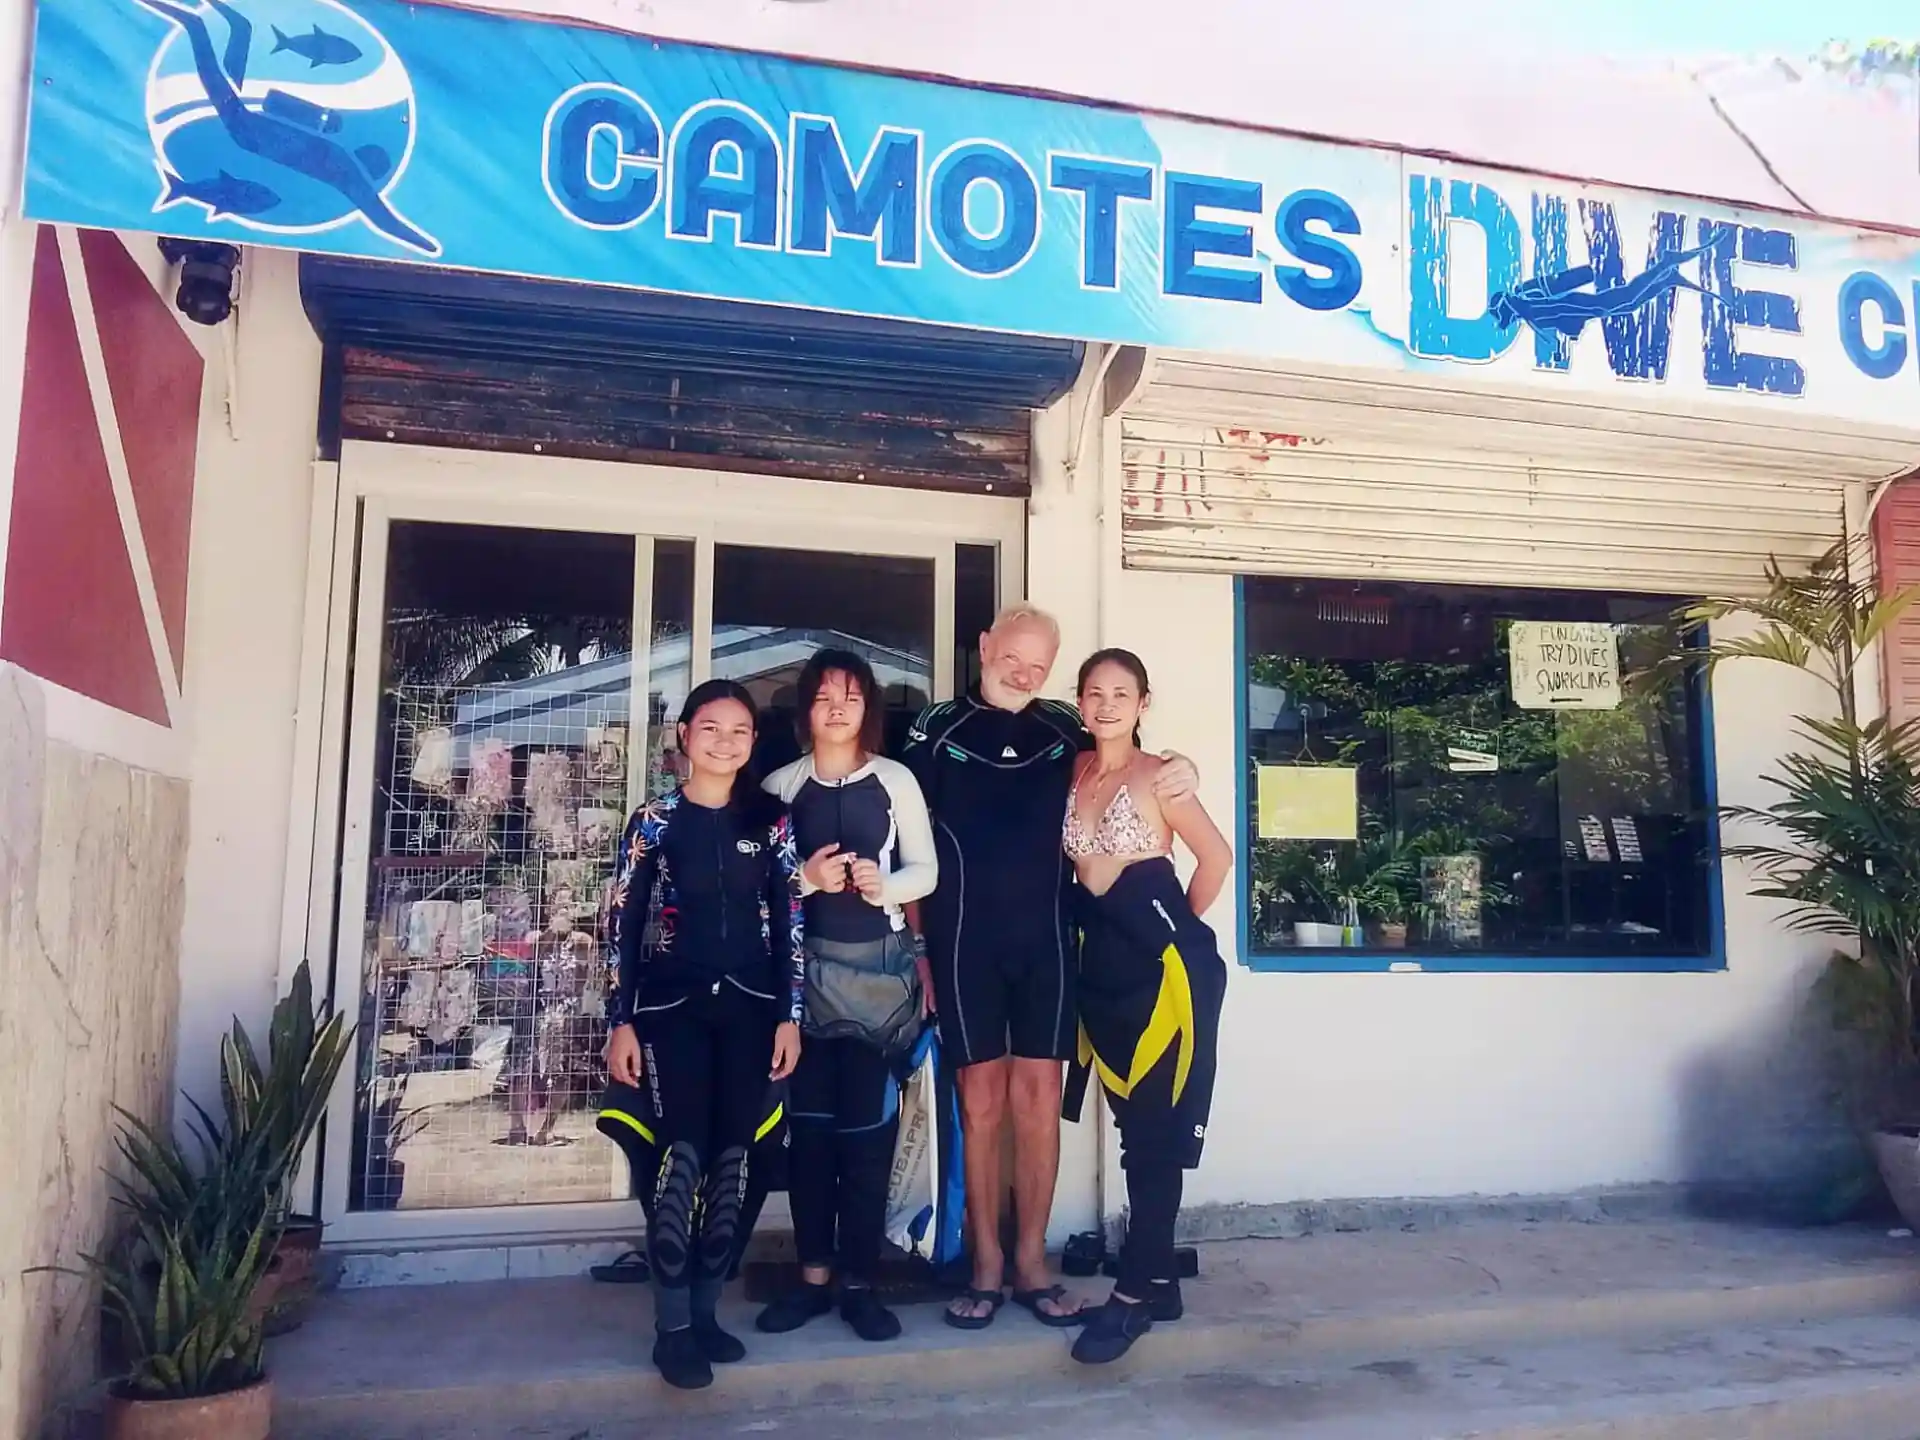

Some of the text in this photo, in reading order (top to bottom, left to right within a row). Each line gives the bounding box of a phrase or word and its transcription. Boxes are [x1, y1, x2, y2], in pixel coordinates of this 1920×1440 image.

[543, 82, 1920, 397] CAMOTES DIVE C
[1540, 623, 1568, 641] FUN
[1538, 643, 1609, 668] TRY DIVES
